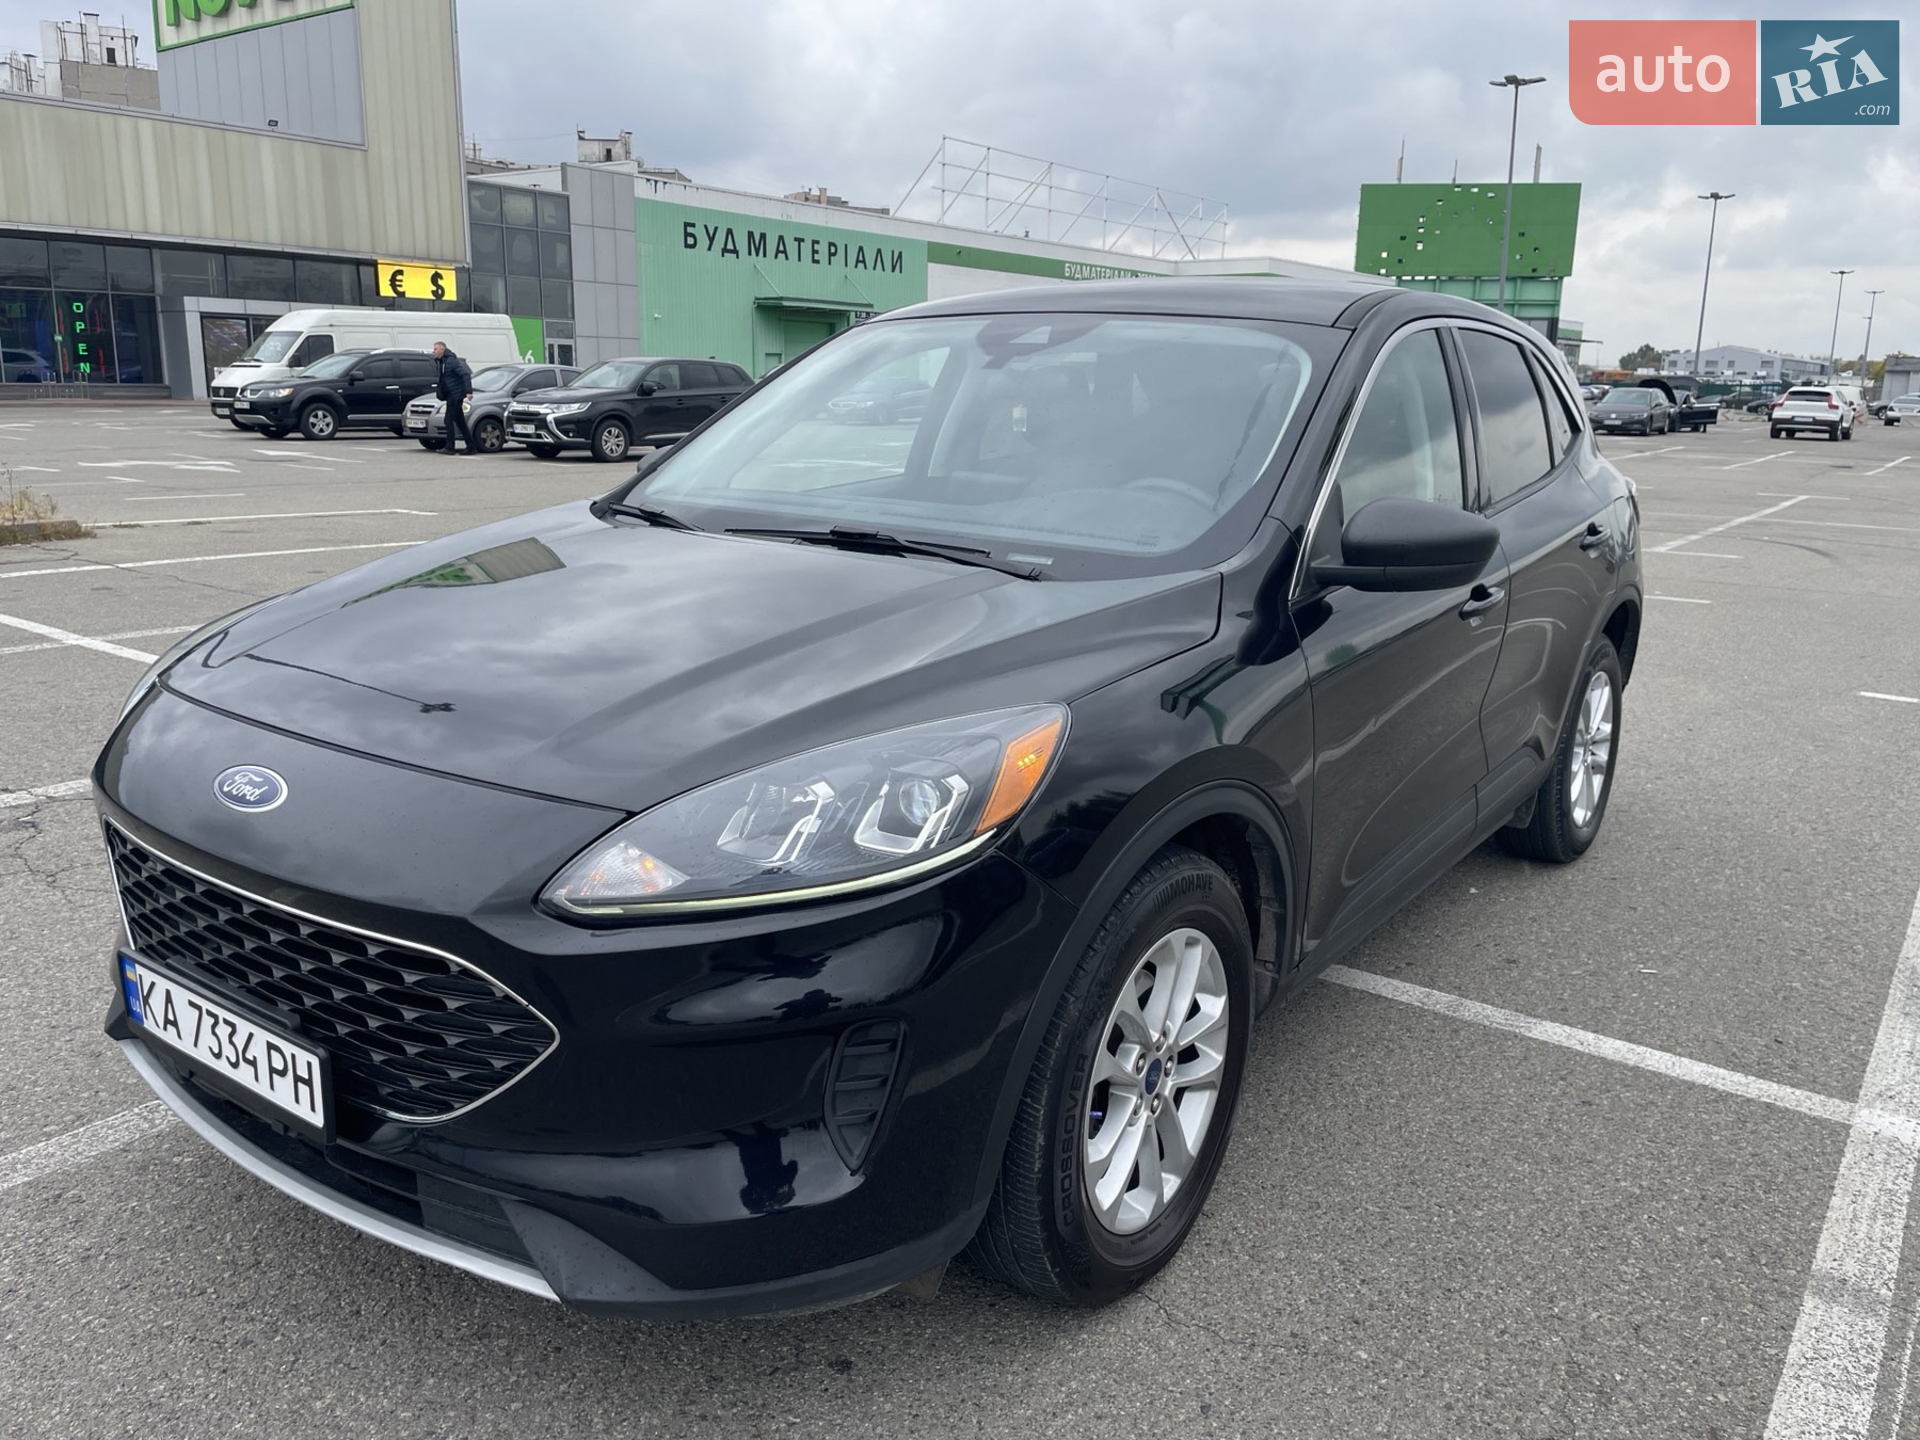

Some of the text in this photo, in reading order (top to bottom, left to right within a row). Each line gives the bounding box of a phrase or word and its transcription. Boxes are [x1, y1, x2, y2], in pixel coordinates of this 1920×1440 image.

[683, 221, 903, 274] БУДМАТЕРІАЛИ
[72, 302, 91, 374] OPEN
[223, 771, 269, 801] Ford
[1169, 873, 1214, 899] MOHAVE
[138, 973, 316, 1114] KA 7334 PH
[1060, 1053, 1090, 1228] CROSSOVER
